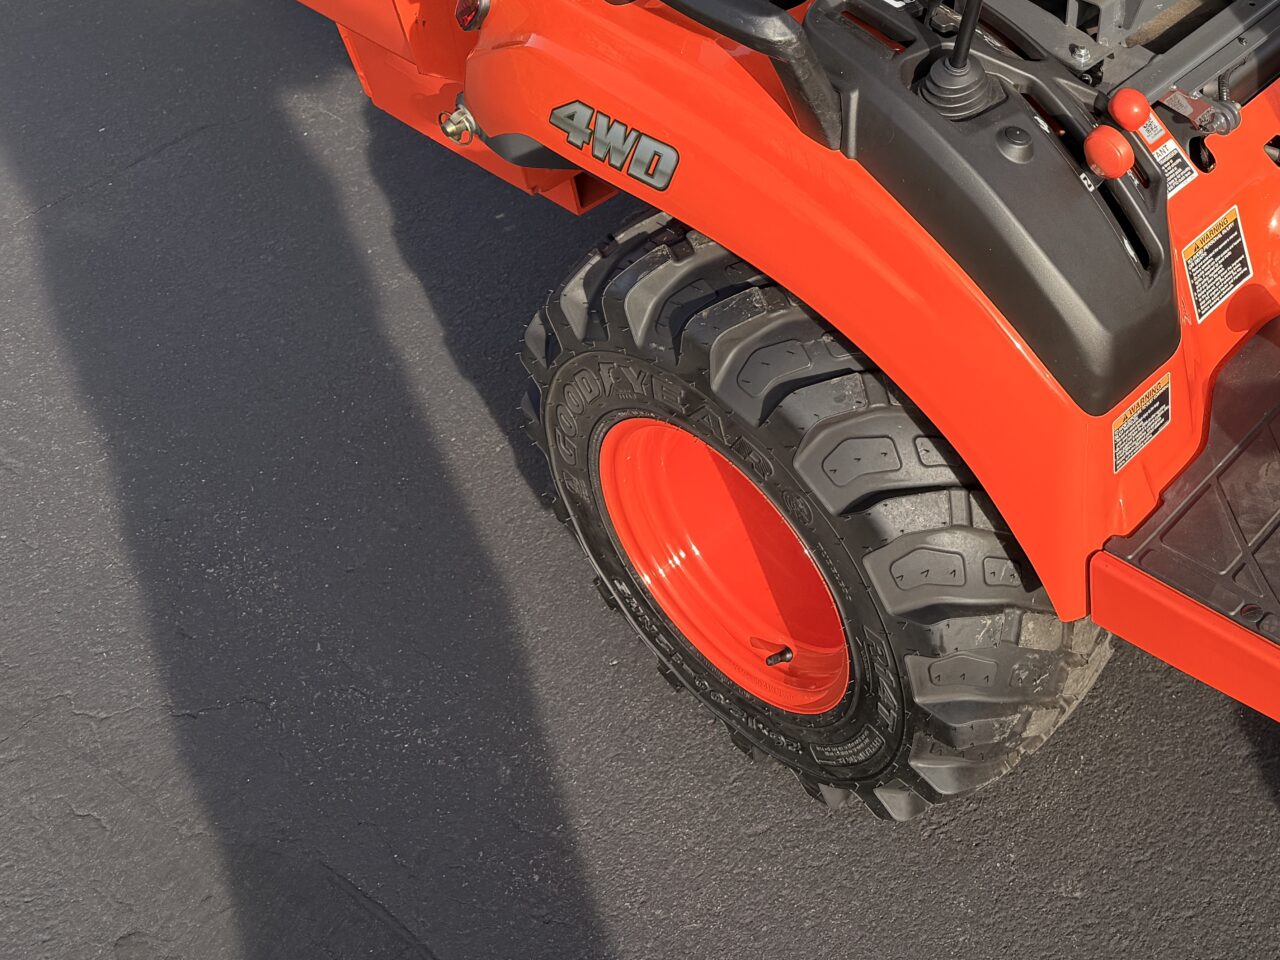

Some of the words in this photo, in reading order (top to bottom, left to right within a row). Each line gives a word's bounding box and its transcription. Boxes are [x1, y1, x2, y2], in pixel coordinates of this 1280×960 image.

[549, 100, 680, 192] 4WD
[1200, 217, 1229, 246] WARNING
[554, 361, 774, 480] GOODYEAR
[1129, 382, 1162, 415] WARNING
